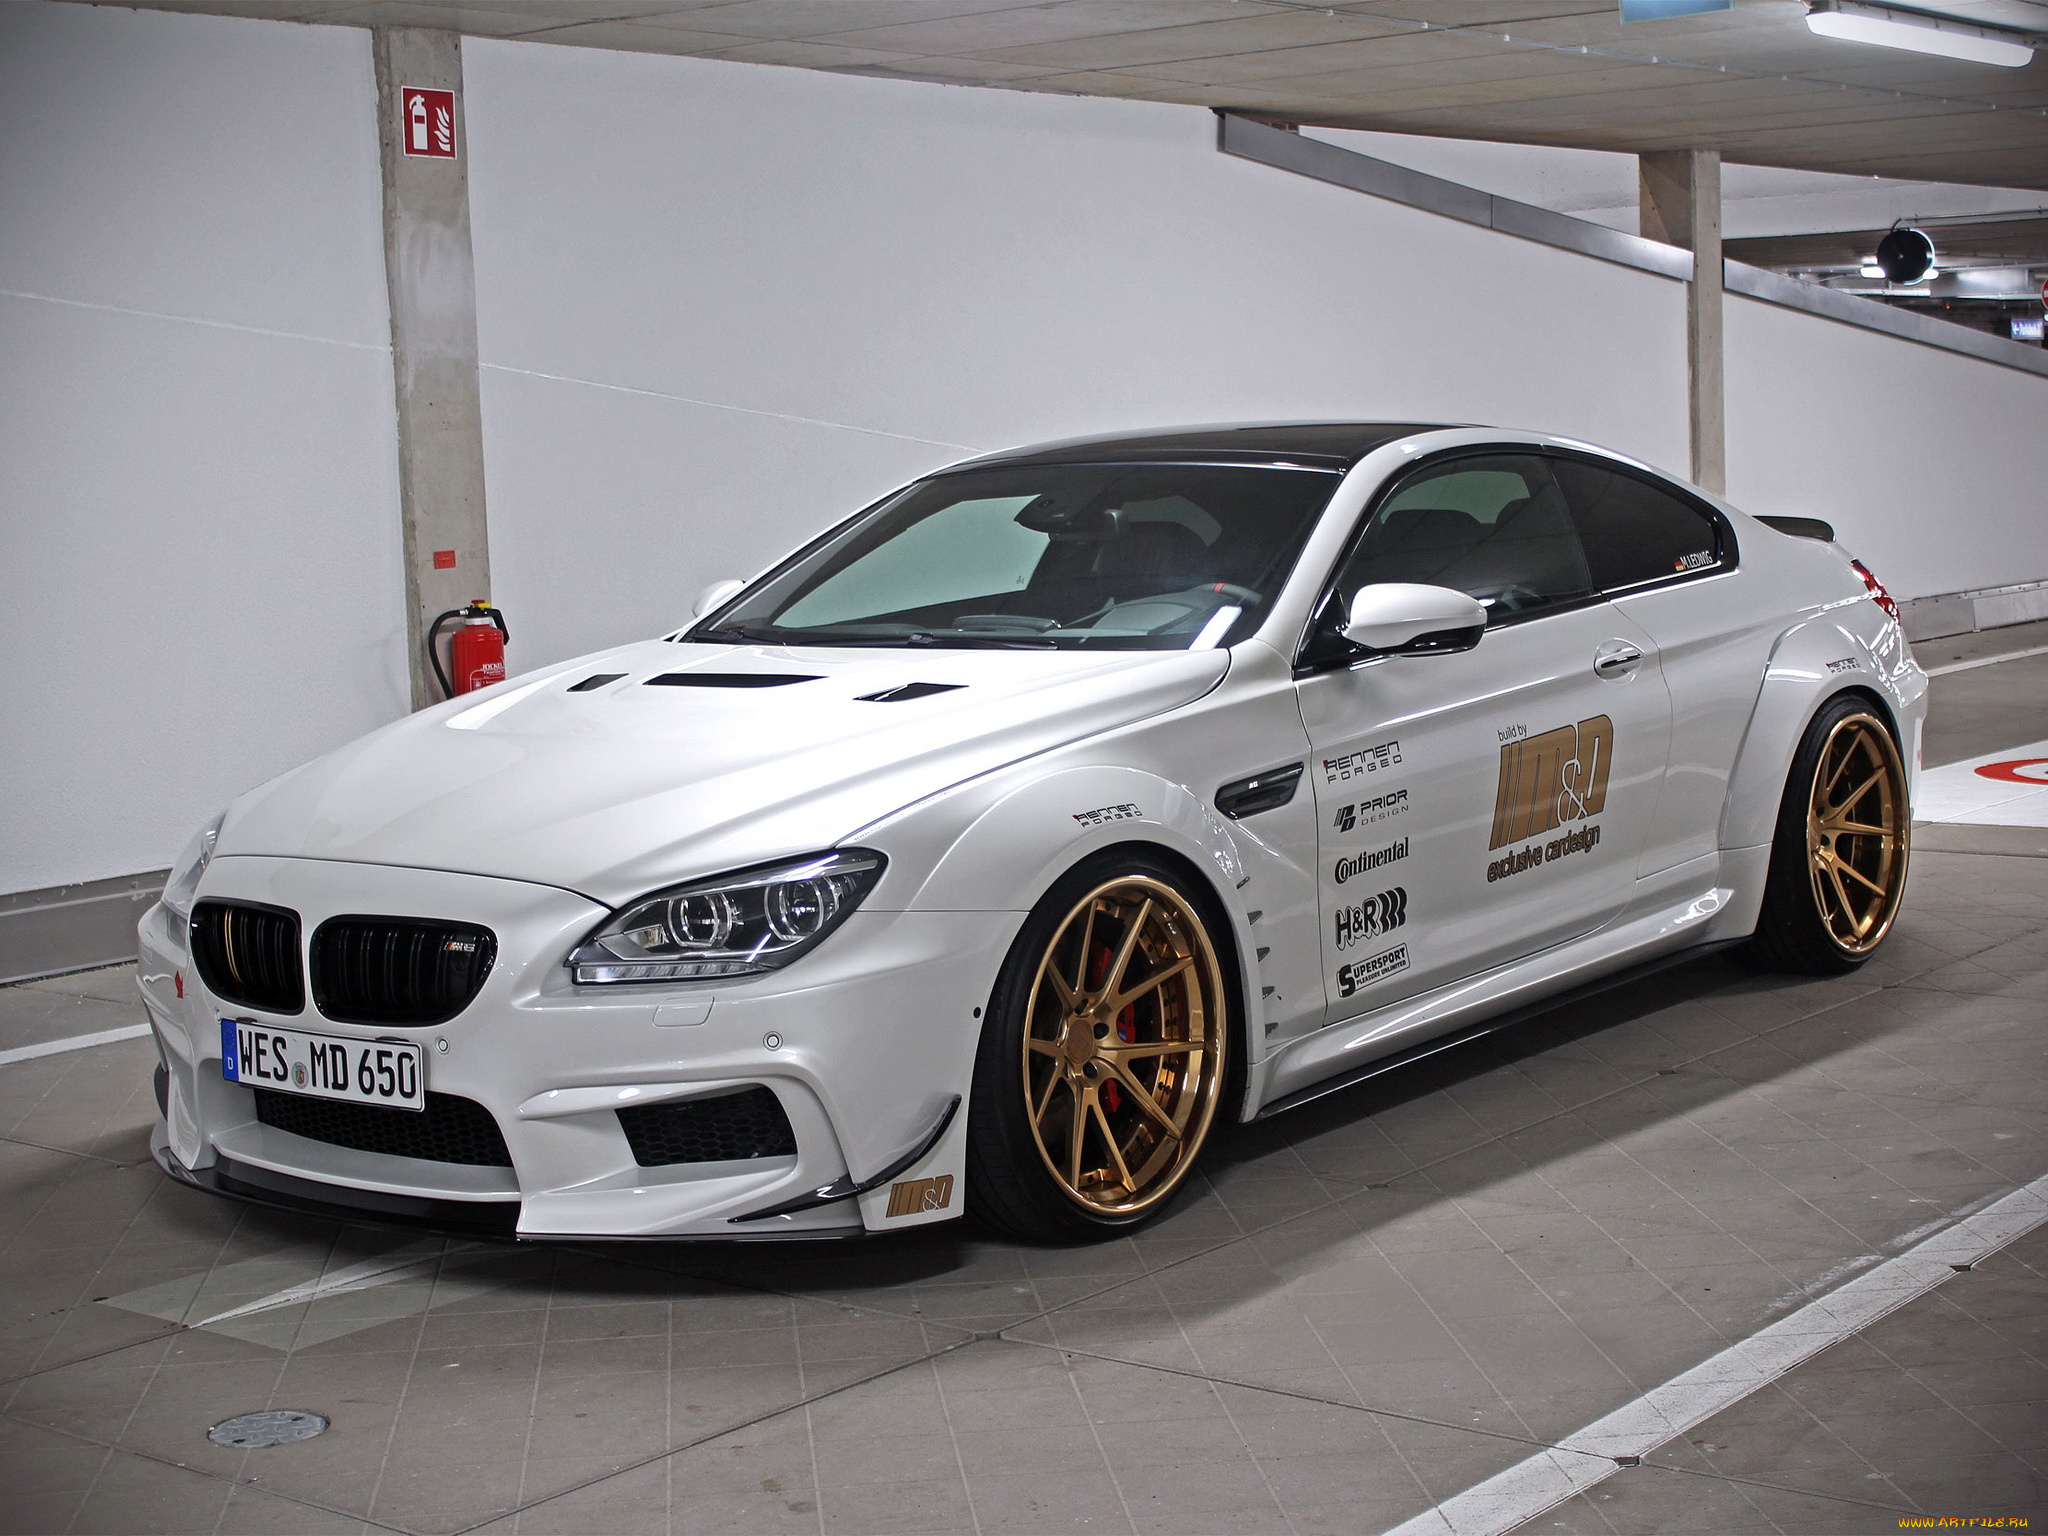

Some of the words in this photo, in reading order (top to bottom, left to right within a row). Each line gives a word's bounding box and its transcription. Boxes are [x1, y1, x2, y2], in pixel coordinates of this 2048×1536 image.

[1497, 725, 1517, 742] build
[1516, 723, 1527, 738] by
[1323, 741, 1400, 774] RENNEN
[1327, 754, 1402, 785] FORGED
[1360, 789, 1408, 815] PRIOR
[1361, 805, 1409, 826] DESIGN
[1081, 811, 1143, 828] FORGED
[1334, 836, 1409, 885] Continental
[1487, 845, 1543, 883] exclusive
[1545, 825, 1600, 862] cardesign
[1335, 897, 1381, 951] H&R
[1338, 946, 1406, 998] SUPERSPORT
[227, 1056, 234, 1071] D
[238, 1029, 289, 1082] WES
[309, 1040, 349, 1092] MD
[357, 1048, 417, 1100] 650
